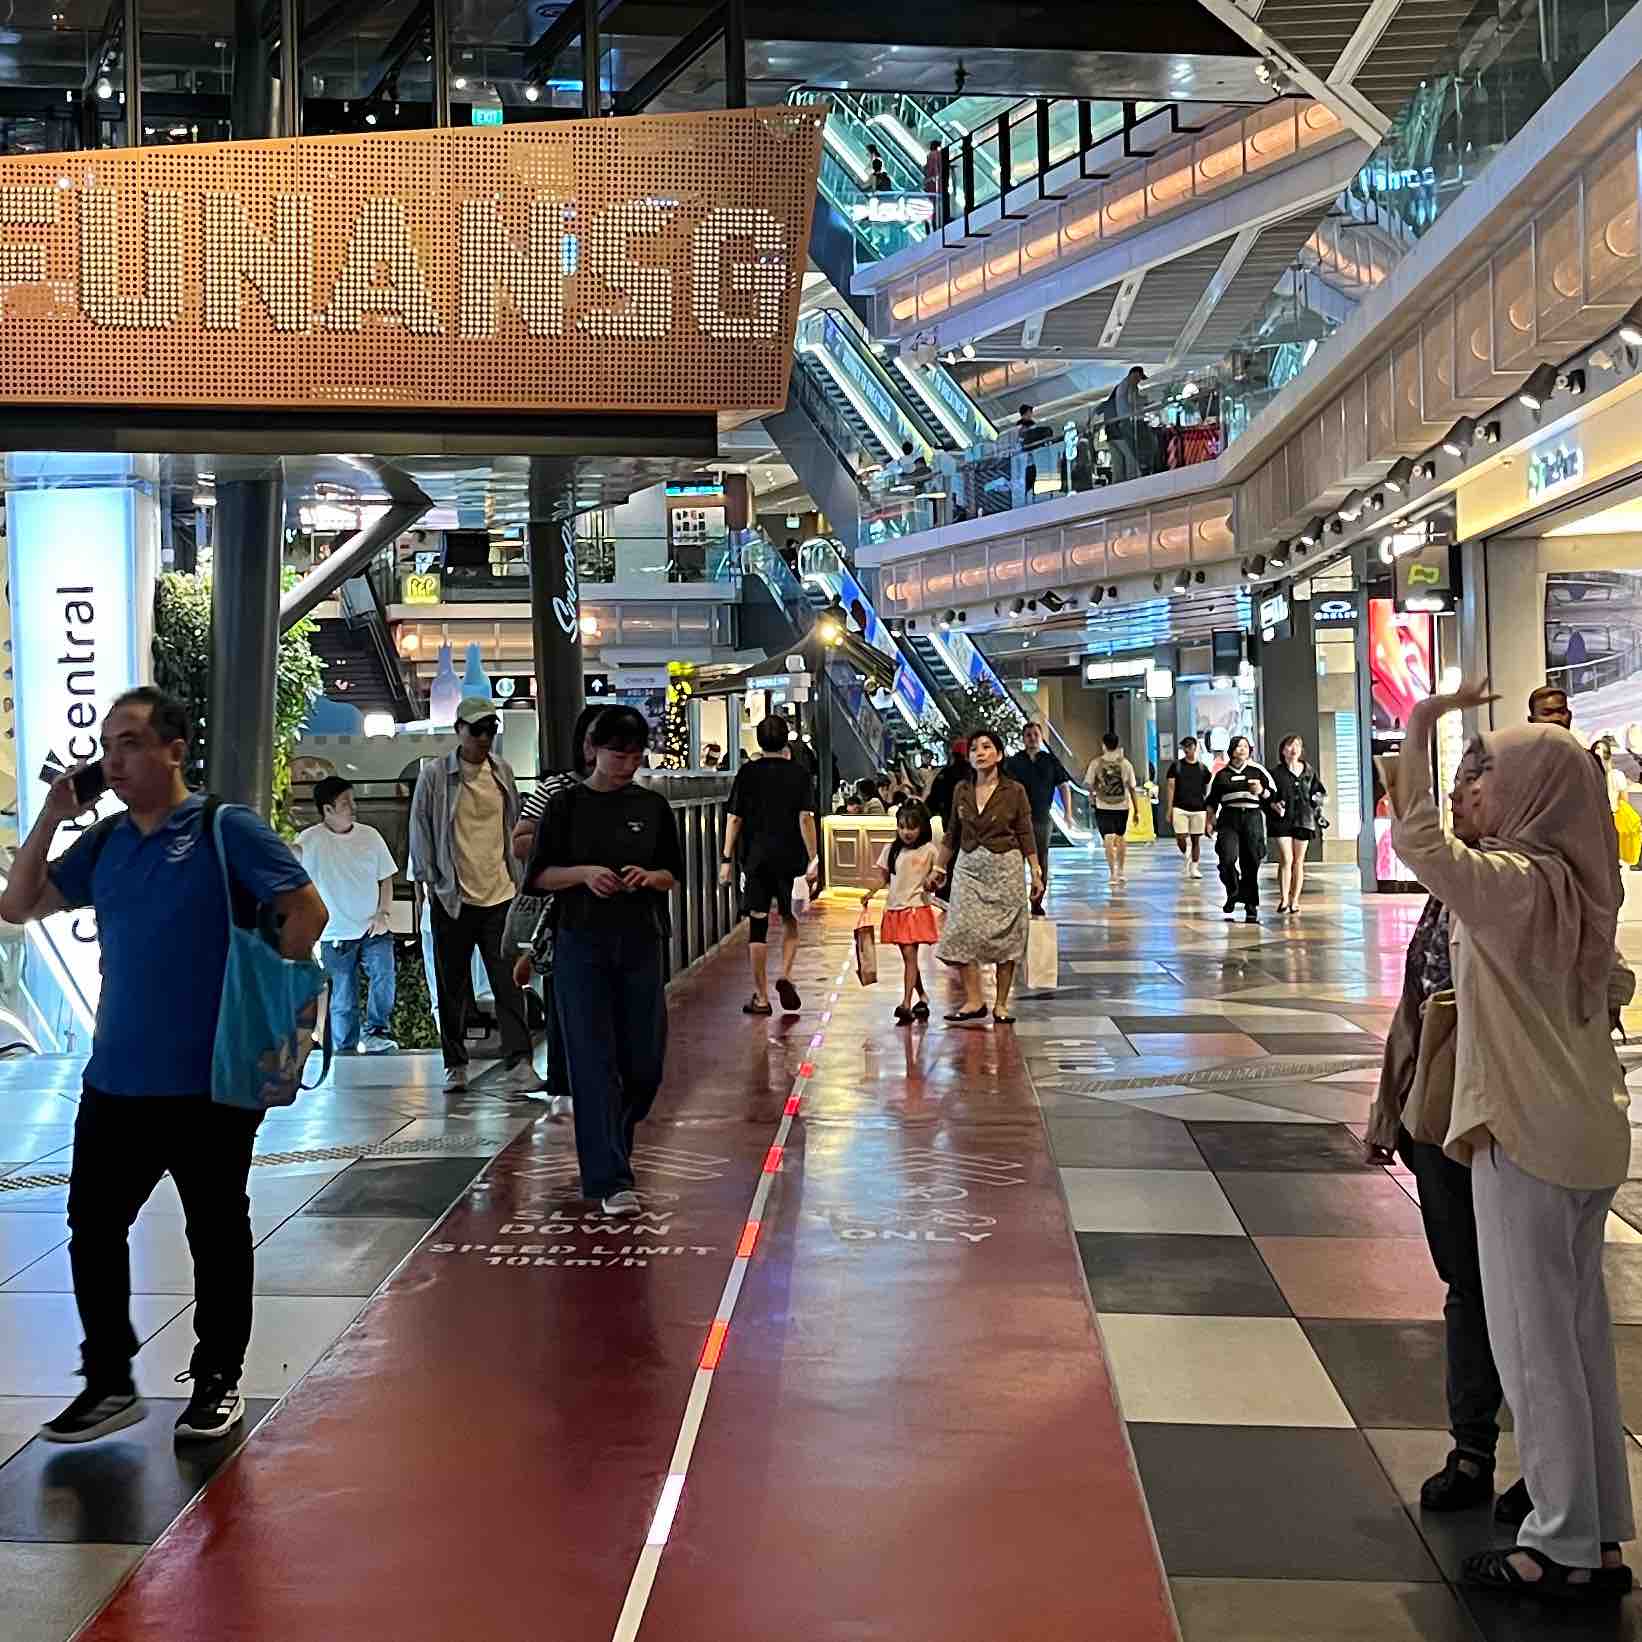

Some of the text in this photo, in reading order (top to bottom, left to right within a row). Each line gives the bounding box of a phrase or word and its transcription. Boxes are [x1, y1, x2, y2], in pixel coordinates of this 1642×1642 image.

[56, 585, 98, 761] central
[499, 1223, 671, 1235] DOWN
[839, 1228, 993, 1242] ONLY
[428, 1243, 718, 1255] SPEED LIMIT
